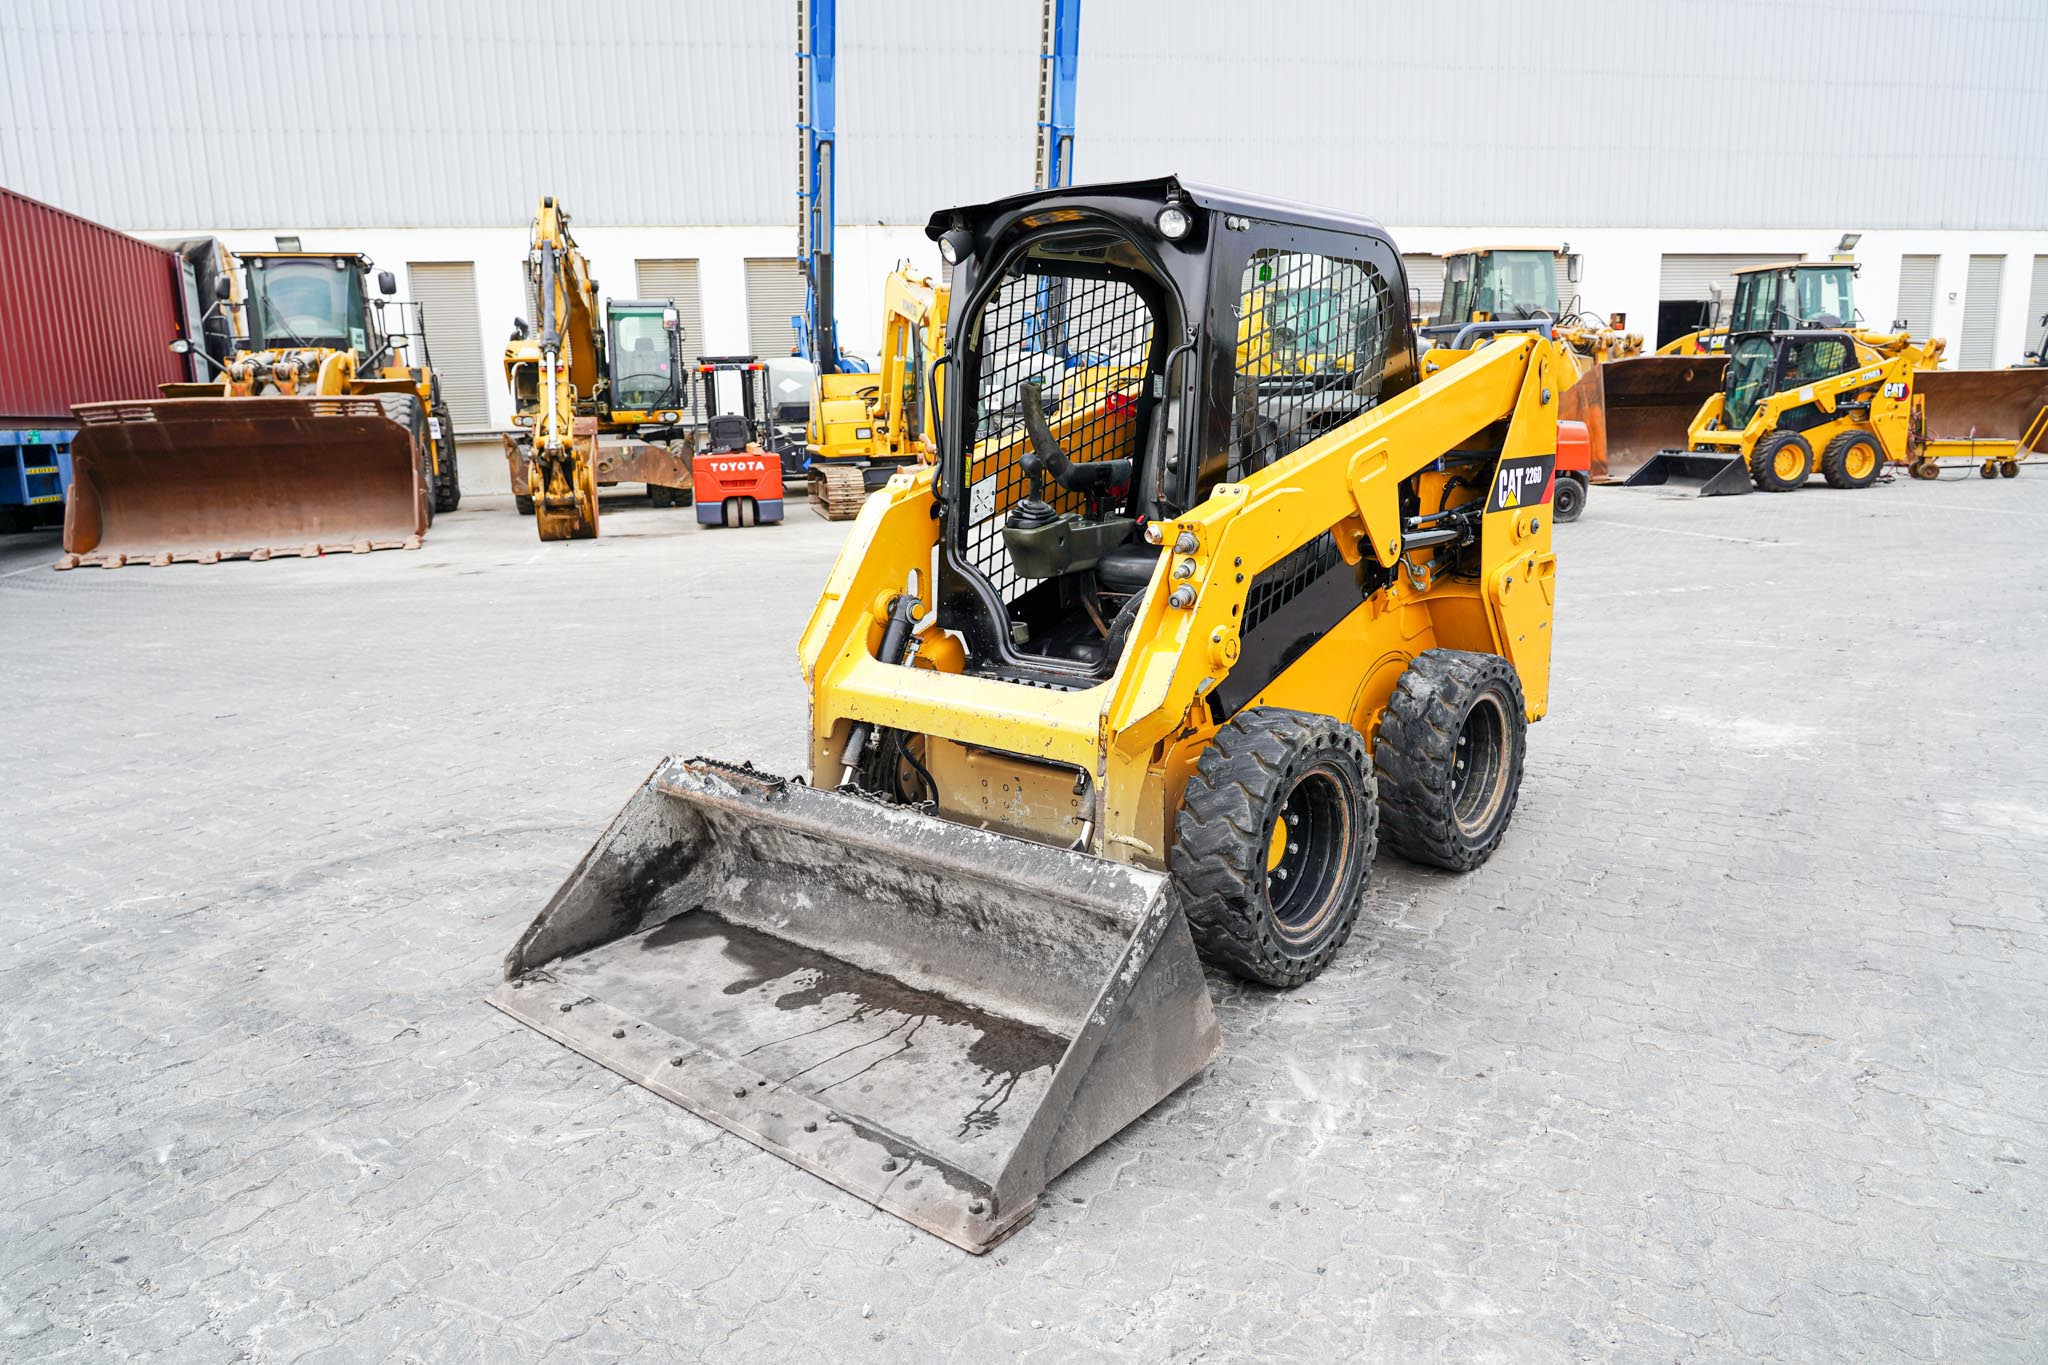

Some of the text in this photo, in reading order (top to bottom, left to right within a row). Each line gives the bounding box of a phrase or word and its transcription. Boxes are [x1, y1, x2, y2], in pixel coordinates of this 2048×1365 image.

[1710, 335, 1728, 349] CAT
[1884, 382, 1906, 398] CAT
[710, 461, 765, 472] TOYOTA
[1498, 466, 1543, 509] CAT 226D
